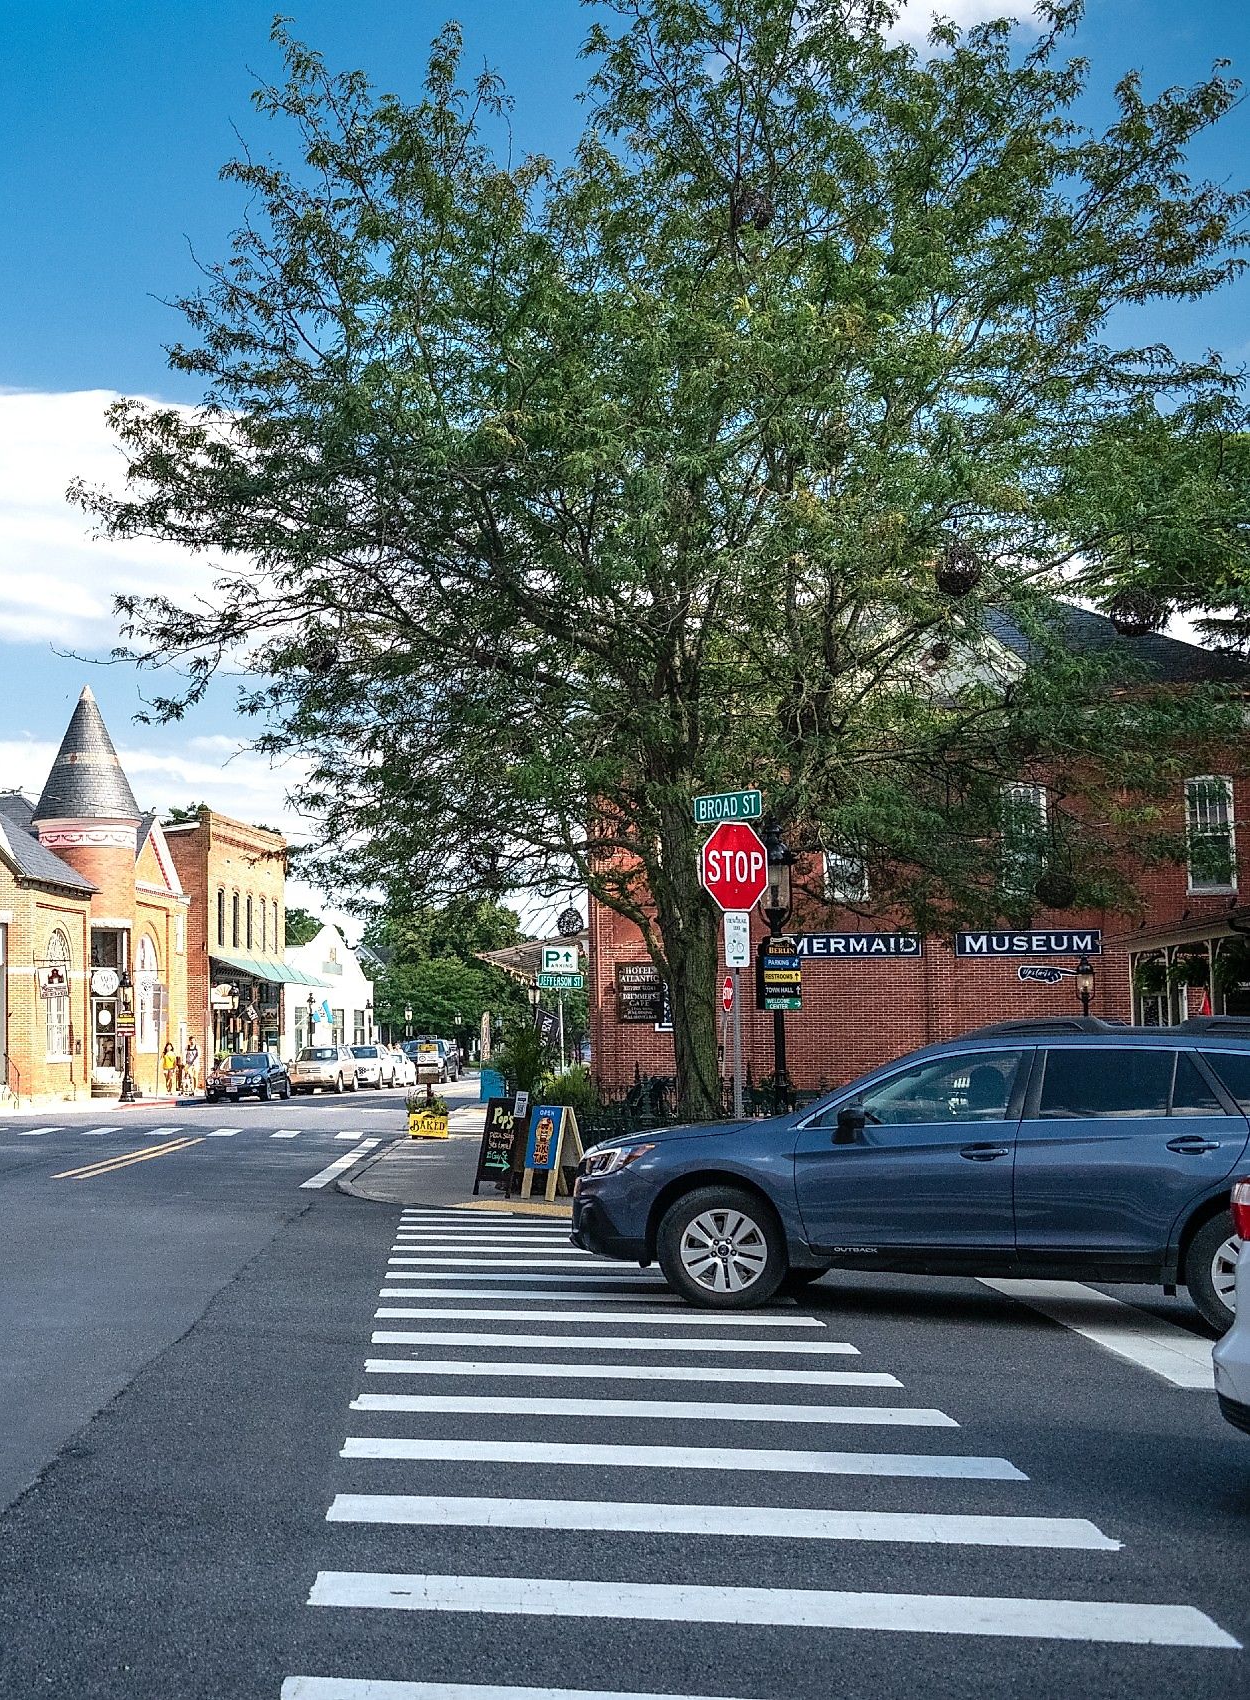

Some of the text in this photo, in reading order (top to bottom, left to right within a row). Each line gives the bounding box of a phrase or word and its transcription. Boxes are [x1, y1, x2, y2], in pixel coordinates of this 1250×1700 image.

[699, 794, 756, 821] BROAD ST
[707, 850, 763, 883] STOP
[791, 938, 916, 954] MERMAID
[964, 935, 1093, 952] MUSEUM
[625, 967, 654, 975] HOTEL
[539, 976, 581, 986] JEFFERSON ST
[620, 974, 660, 983] ATLANTIC
[722, 987, 733, 1000] STOP
[491, 1107, 514, 1130] Pop's
[409, 1120, 445, 1132] BAKED
